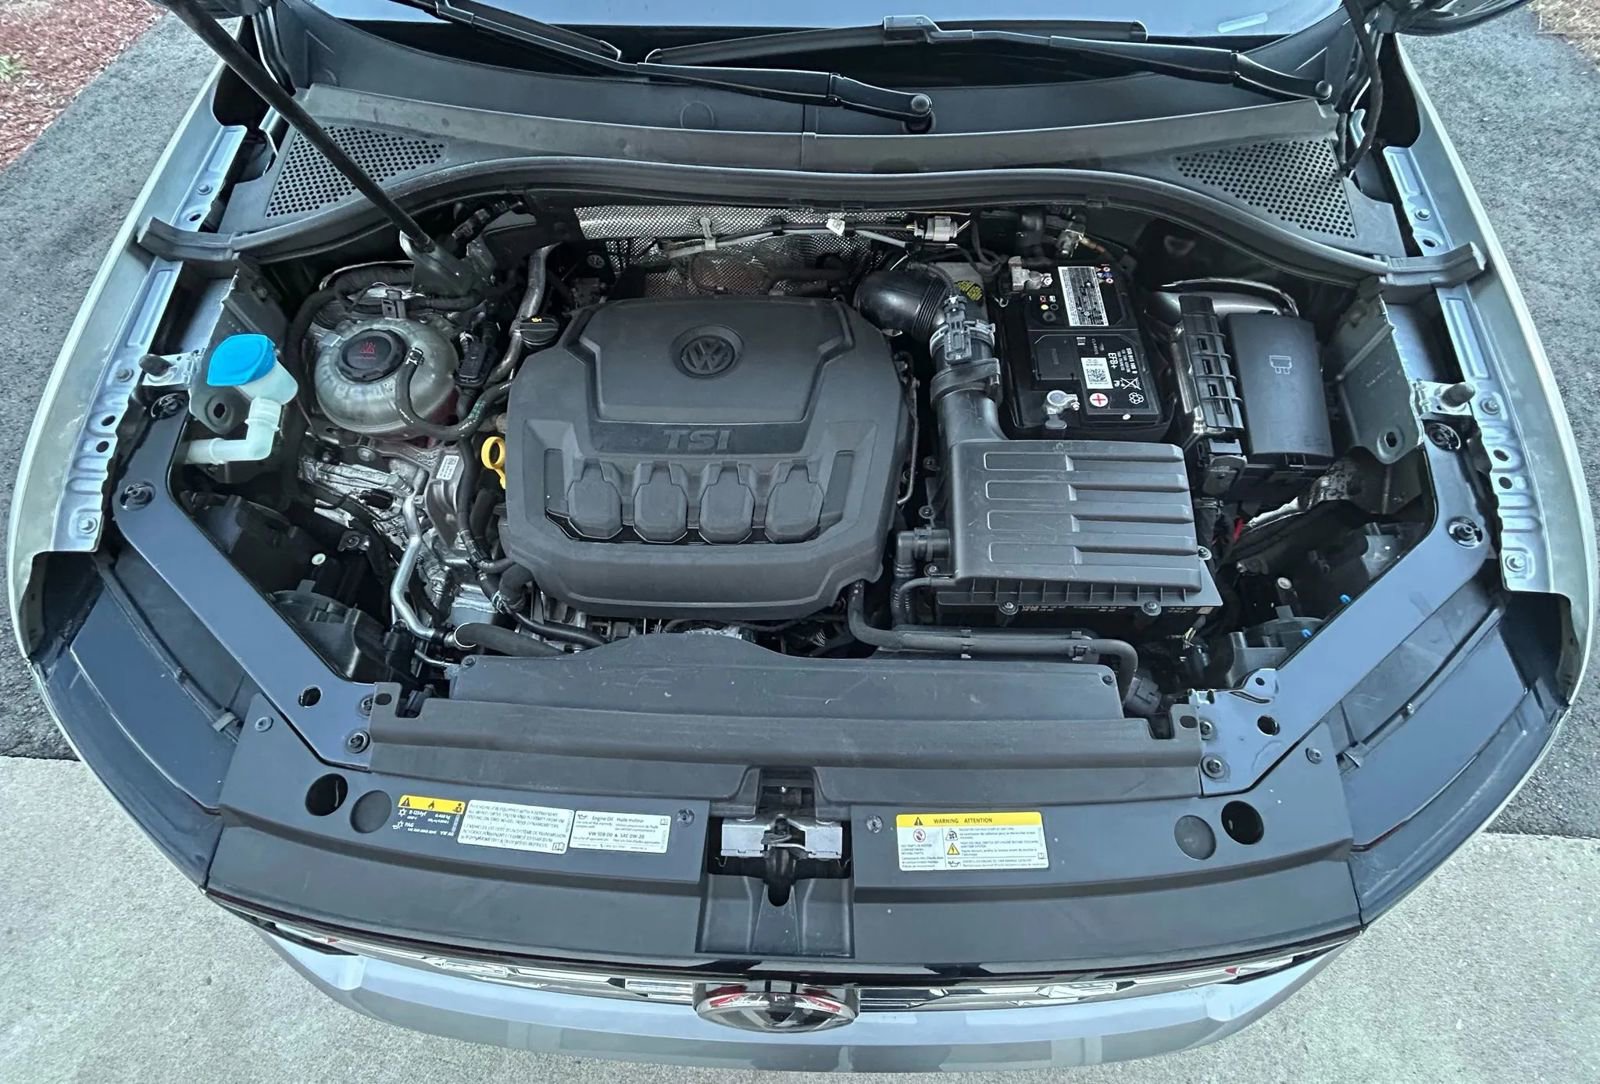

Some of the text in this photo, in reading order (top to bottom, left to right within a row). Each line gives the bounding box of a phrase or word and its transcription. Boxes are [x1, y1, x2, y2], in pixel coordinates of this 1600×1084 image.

[681, 335, 735, 375] VW
[1107, 352, 1119, 369] EFB+
[663, 429, 732, 451] TSI
